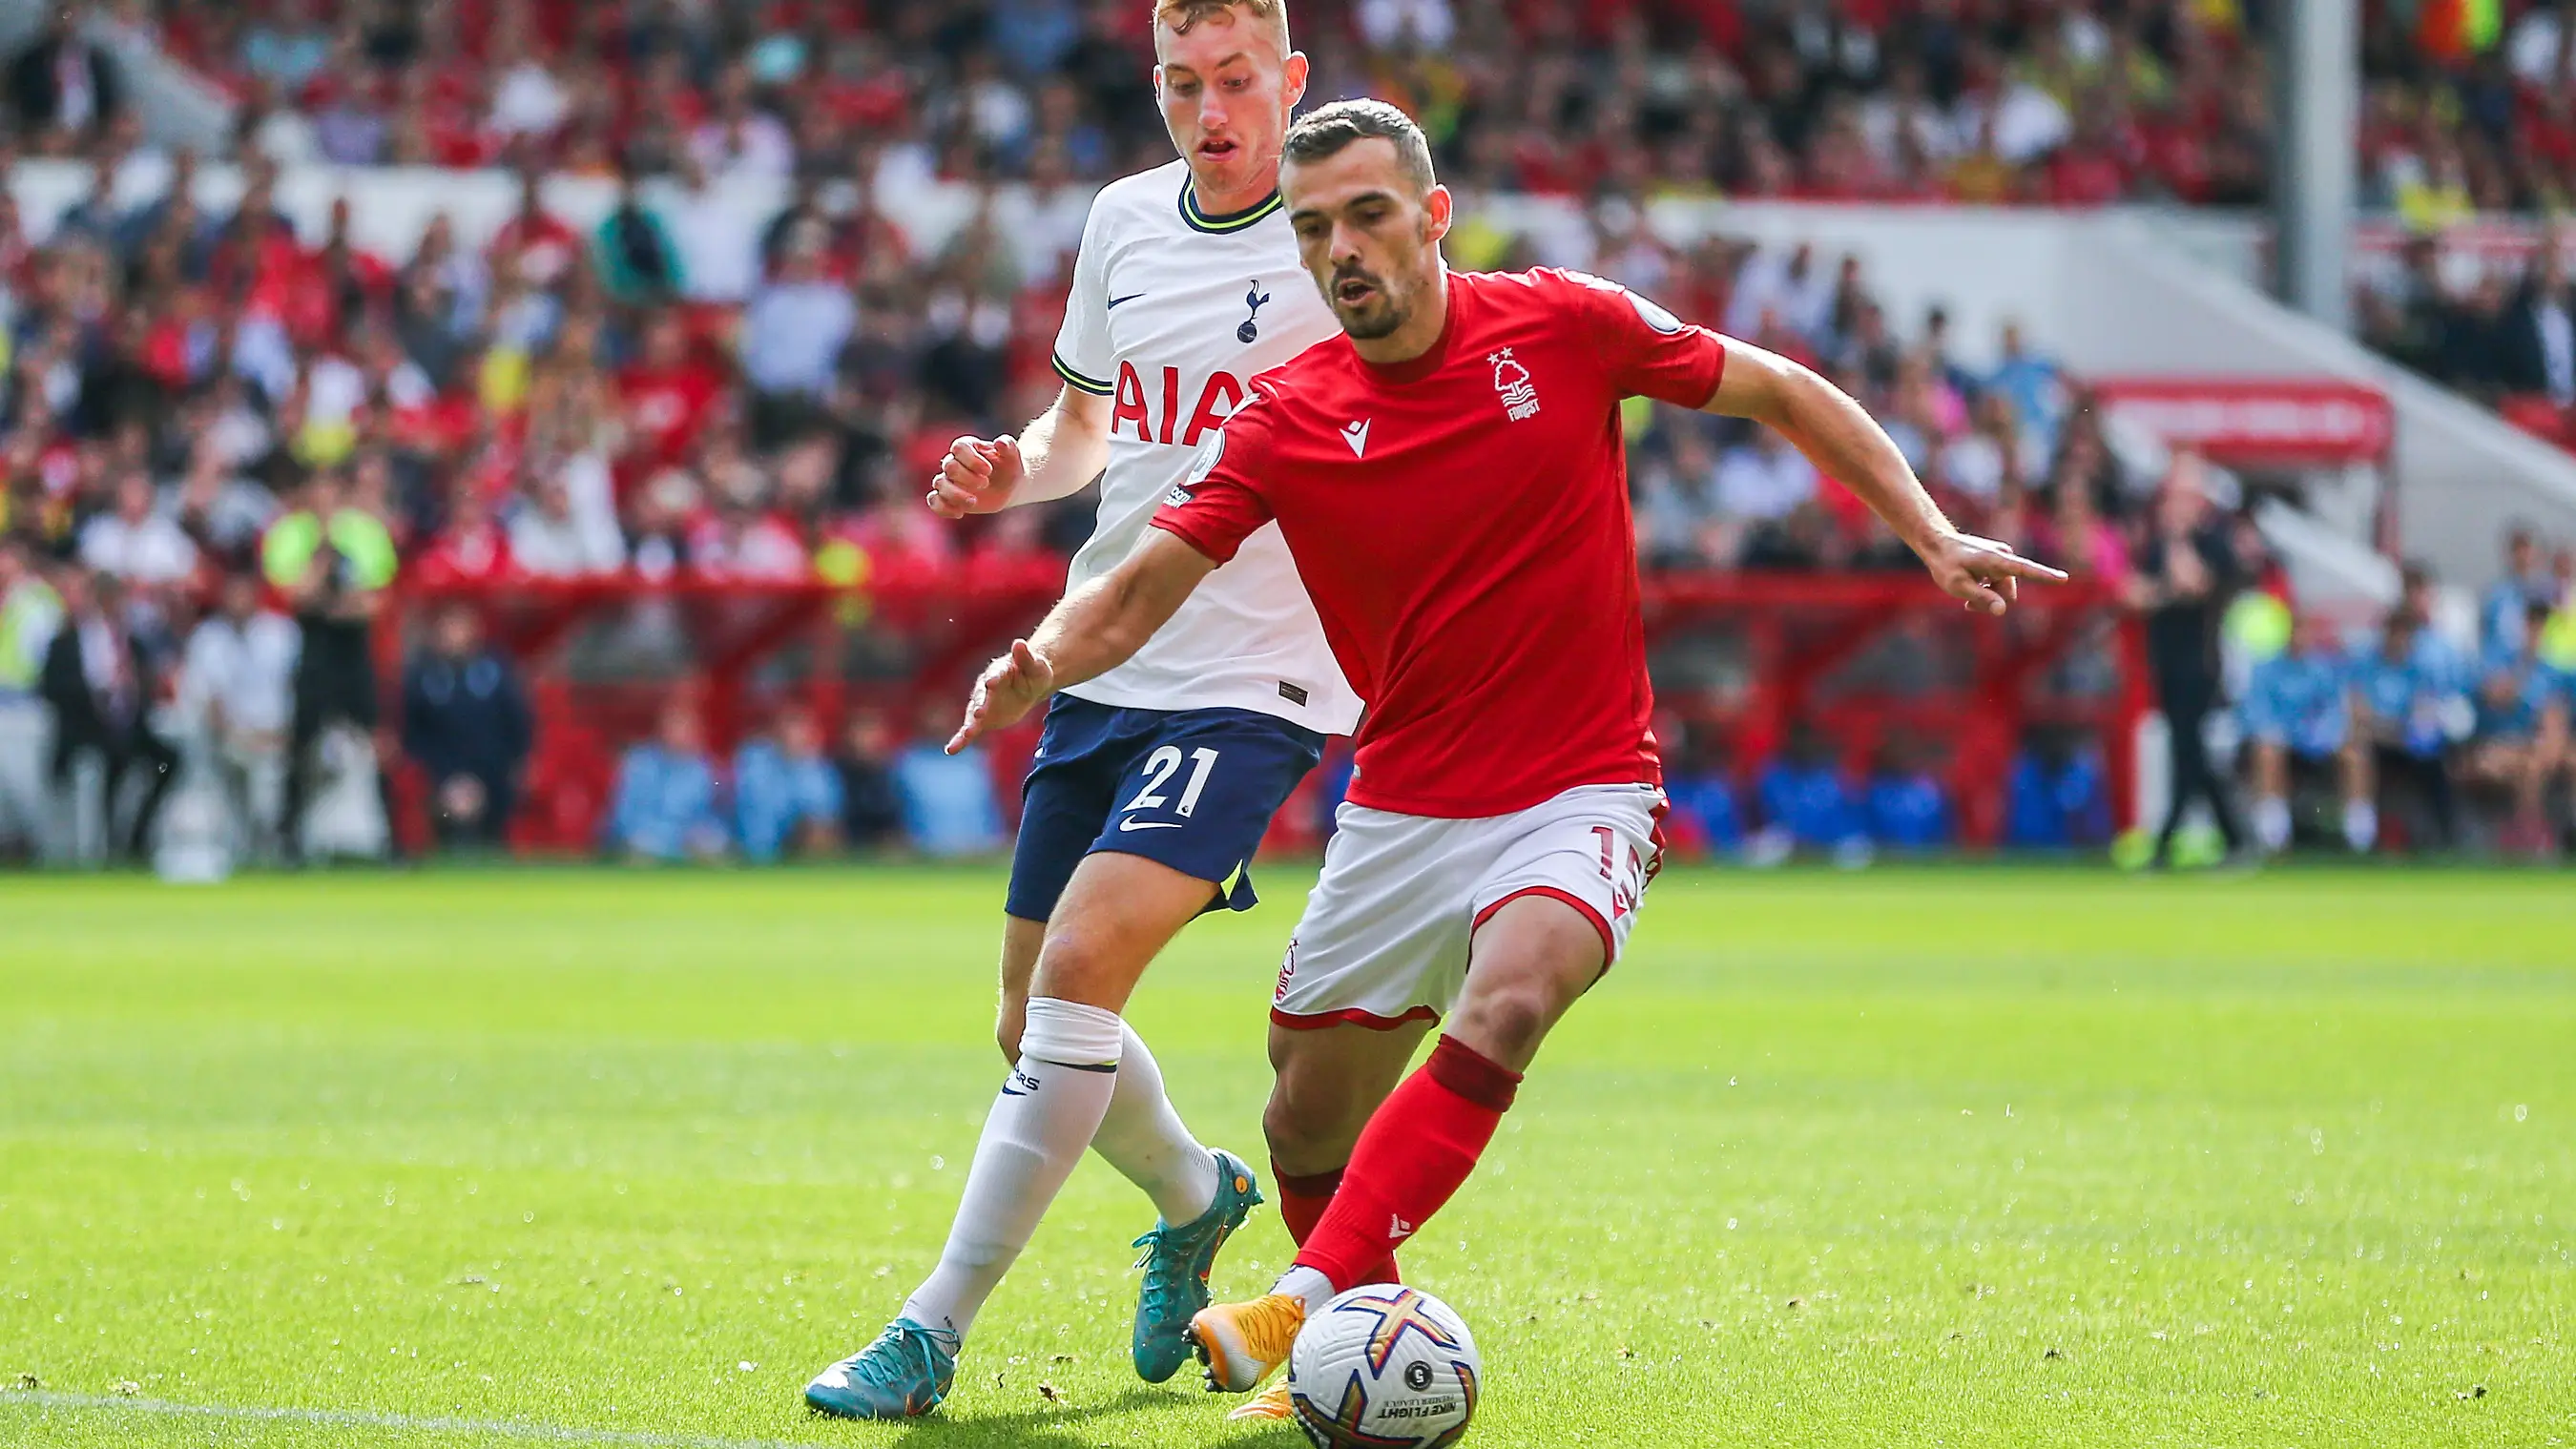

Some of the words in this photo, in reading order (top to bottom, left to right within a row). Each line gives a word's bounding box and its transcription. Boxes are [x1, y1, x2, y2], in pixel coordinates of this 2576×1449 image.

[1111, 360, 1244, 447] AIA
[1507, 398, 1540, 423] FOREST
[1121, 745, 1218, 818] 21
[1414, 1369, 1424, 1383] 5
[1383, 1397, 1420, 1408] LEAGUE
[1422, 1393, 1454, 1406] PREMIER
[1377, 1406, 1430, 1419] FLIGHT
[1430, 1402, 1457, 1418] NIKE
